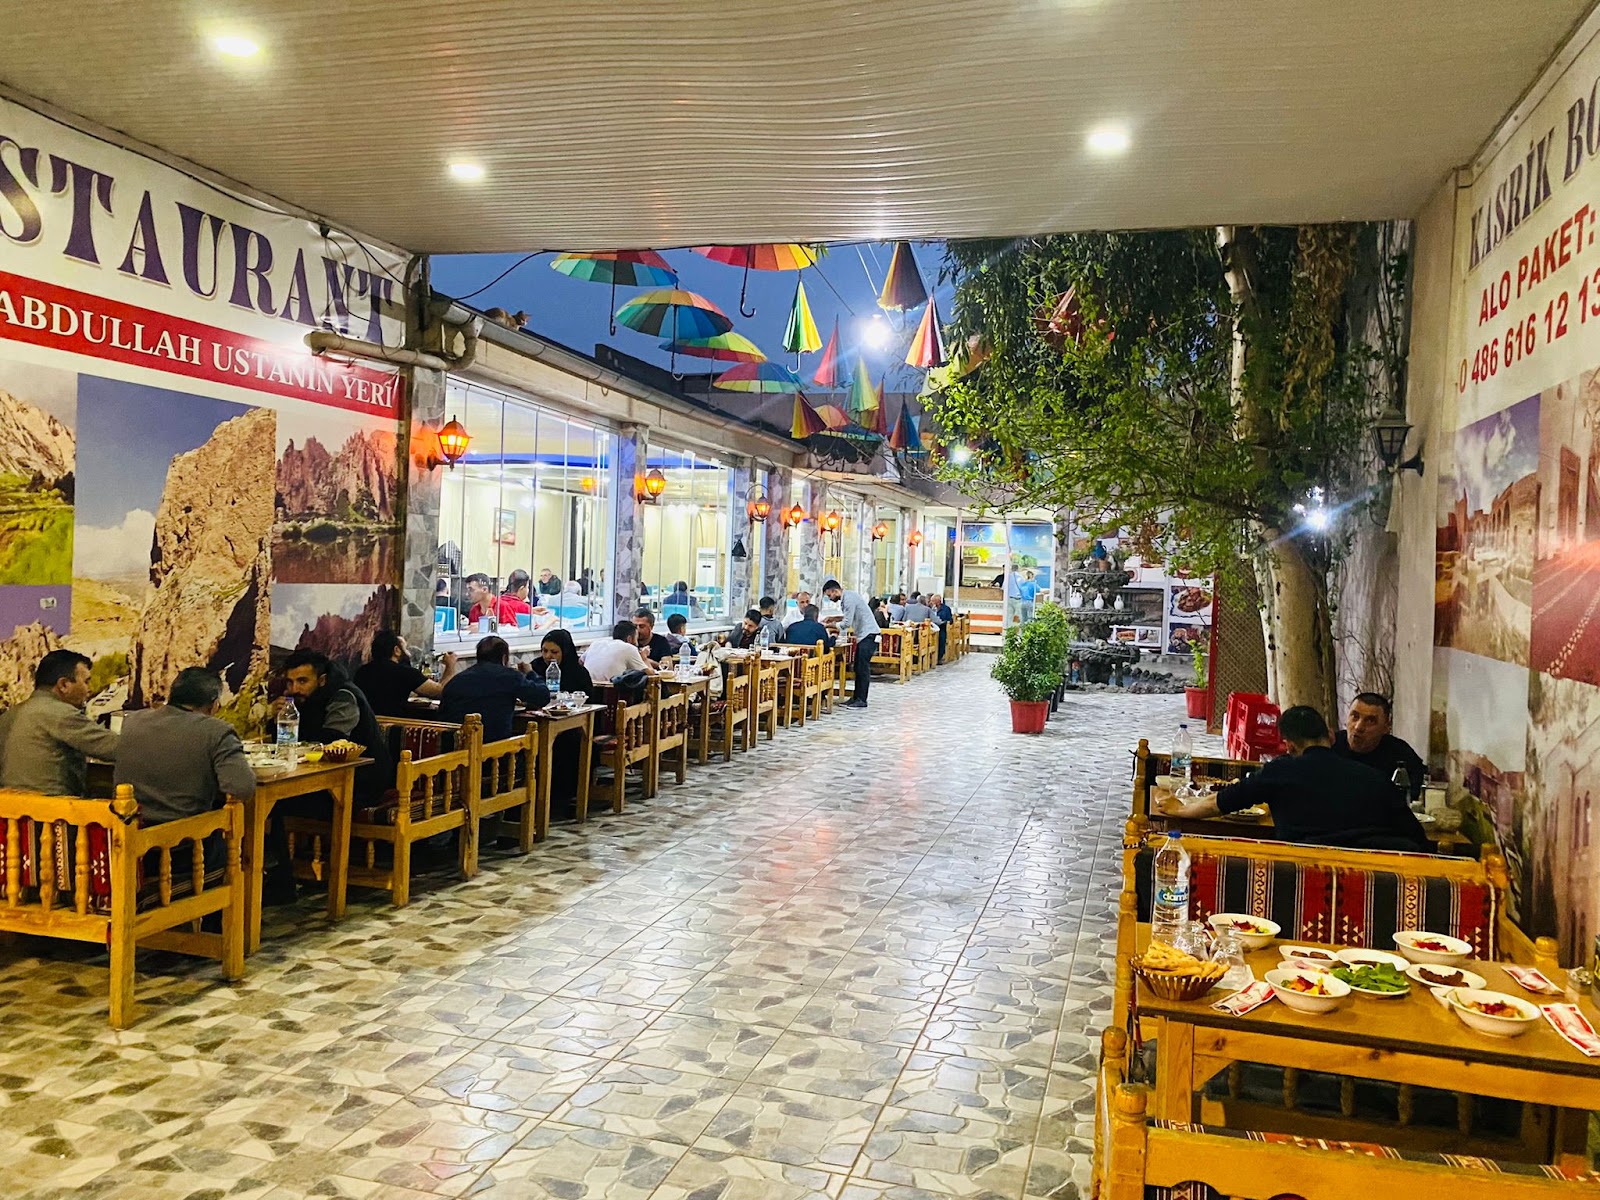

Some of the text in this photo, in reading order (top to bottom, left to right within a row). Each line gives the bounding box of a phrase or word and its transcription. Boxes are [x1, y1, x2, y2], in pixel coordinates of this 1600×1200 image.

[0, 135, 394, 344] STAURANT
[1478, 203, 1596, 327] ALO PAKET:
[0, 290, 202, 366] ABDULLAH
[341, 374, 393, 408] YERİ
[1459, 267, 1600, 394] 0 486 616 12 13
